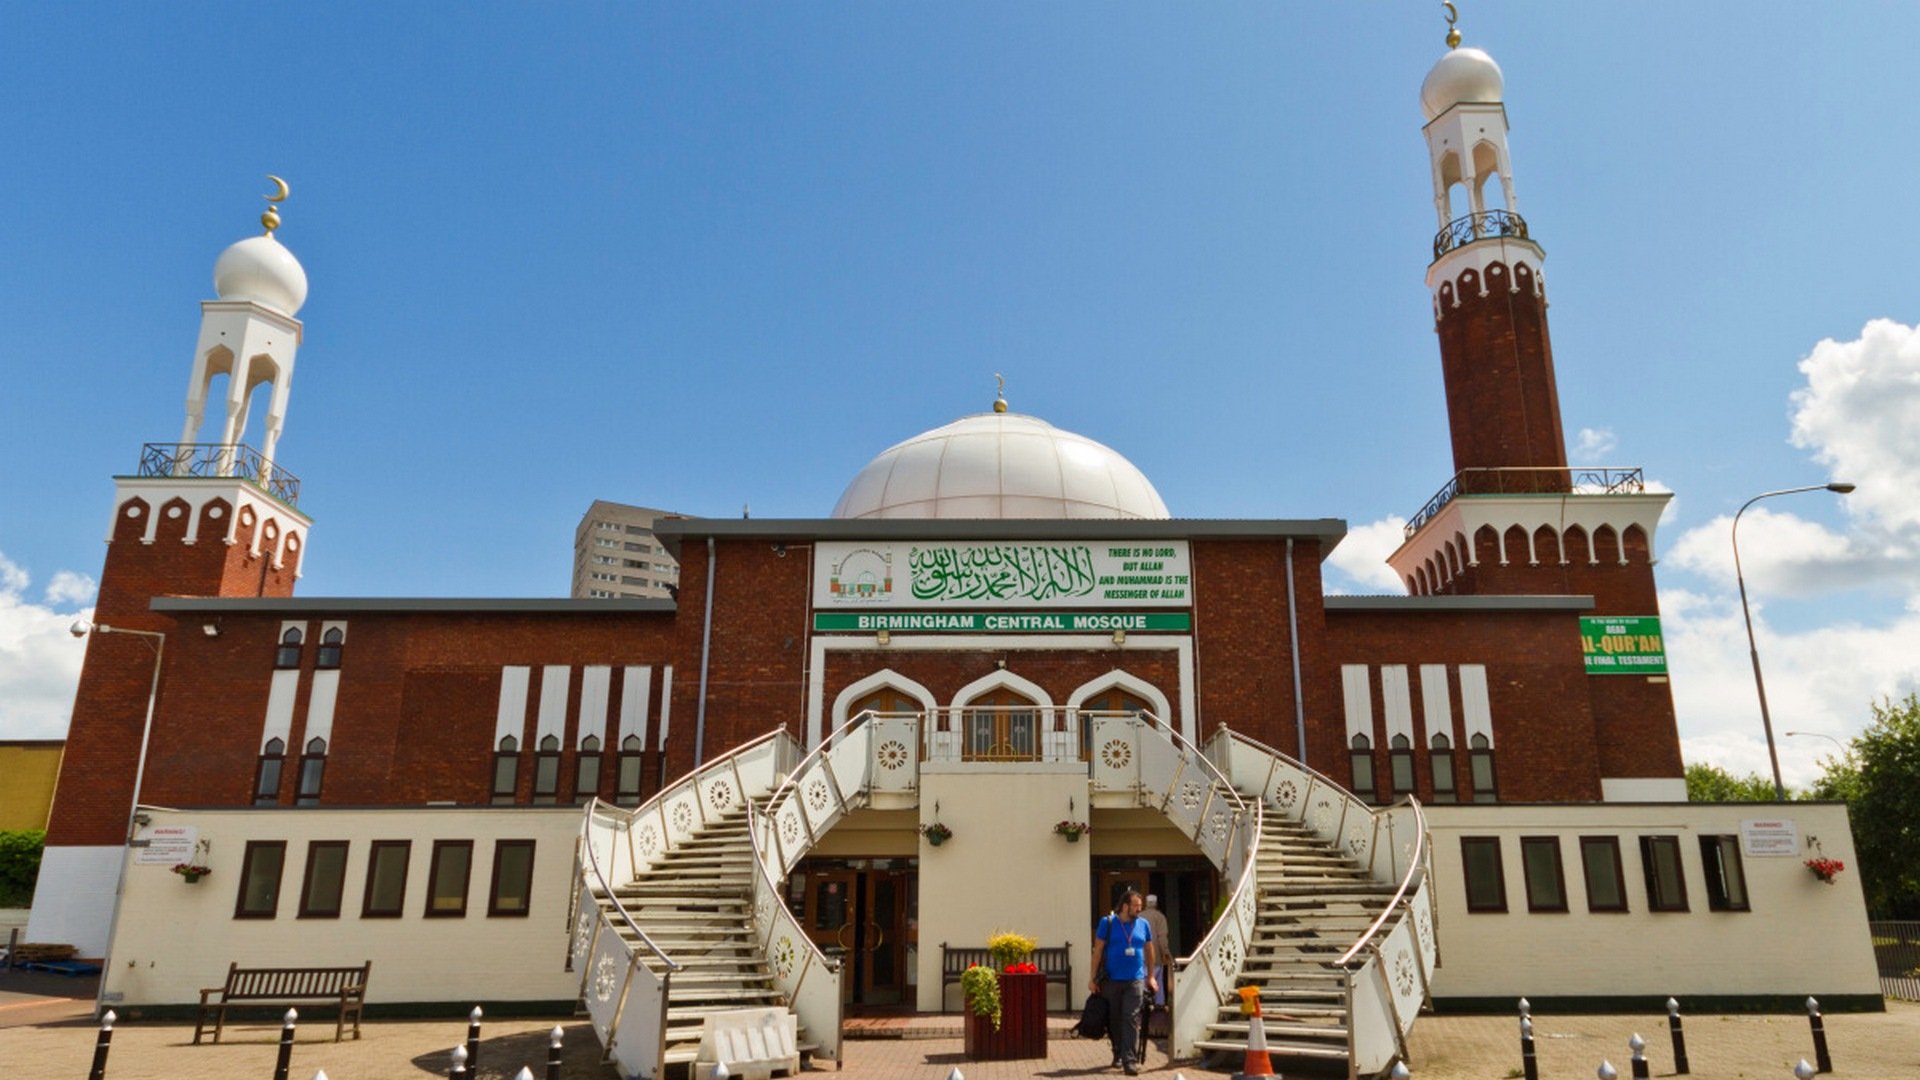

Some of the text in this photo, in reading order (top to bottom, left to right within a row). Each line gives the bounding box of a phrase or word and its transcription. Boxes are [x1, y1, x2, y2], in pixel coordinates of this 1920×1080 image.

[1109, 548, 1176, 558] THERE IS NO LORD,
[1123, 562, 1163, 571] BUT ALLAH
[1099, 576, 1188, 585] AND MUHAMMAD IS THE
[1104, 590, 1184, 599] MESSENGER OF ALLAH
[858, 615, 1147, 629] BIRMINGHAM CENTRAL MOSQUE
[1593, 656, 1616, 665] FINAL
[1617, 656, 1664, 665] TESTAMENT
